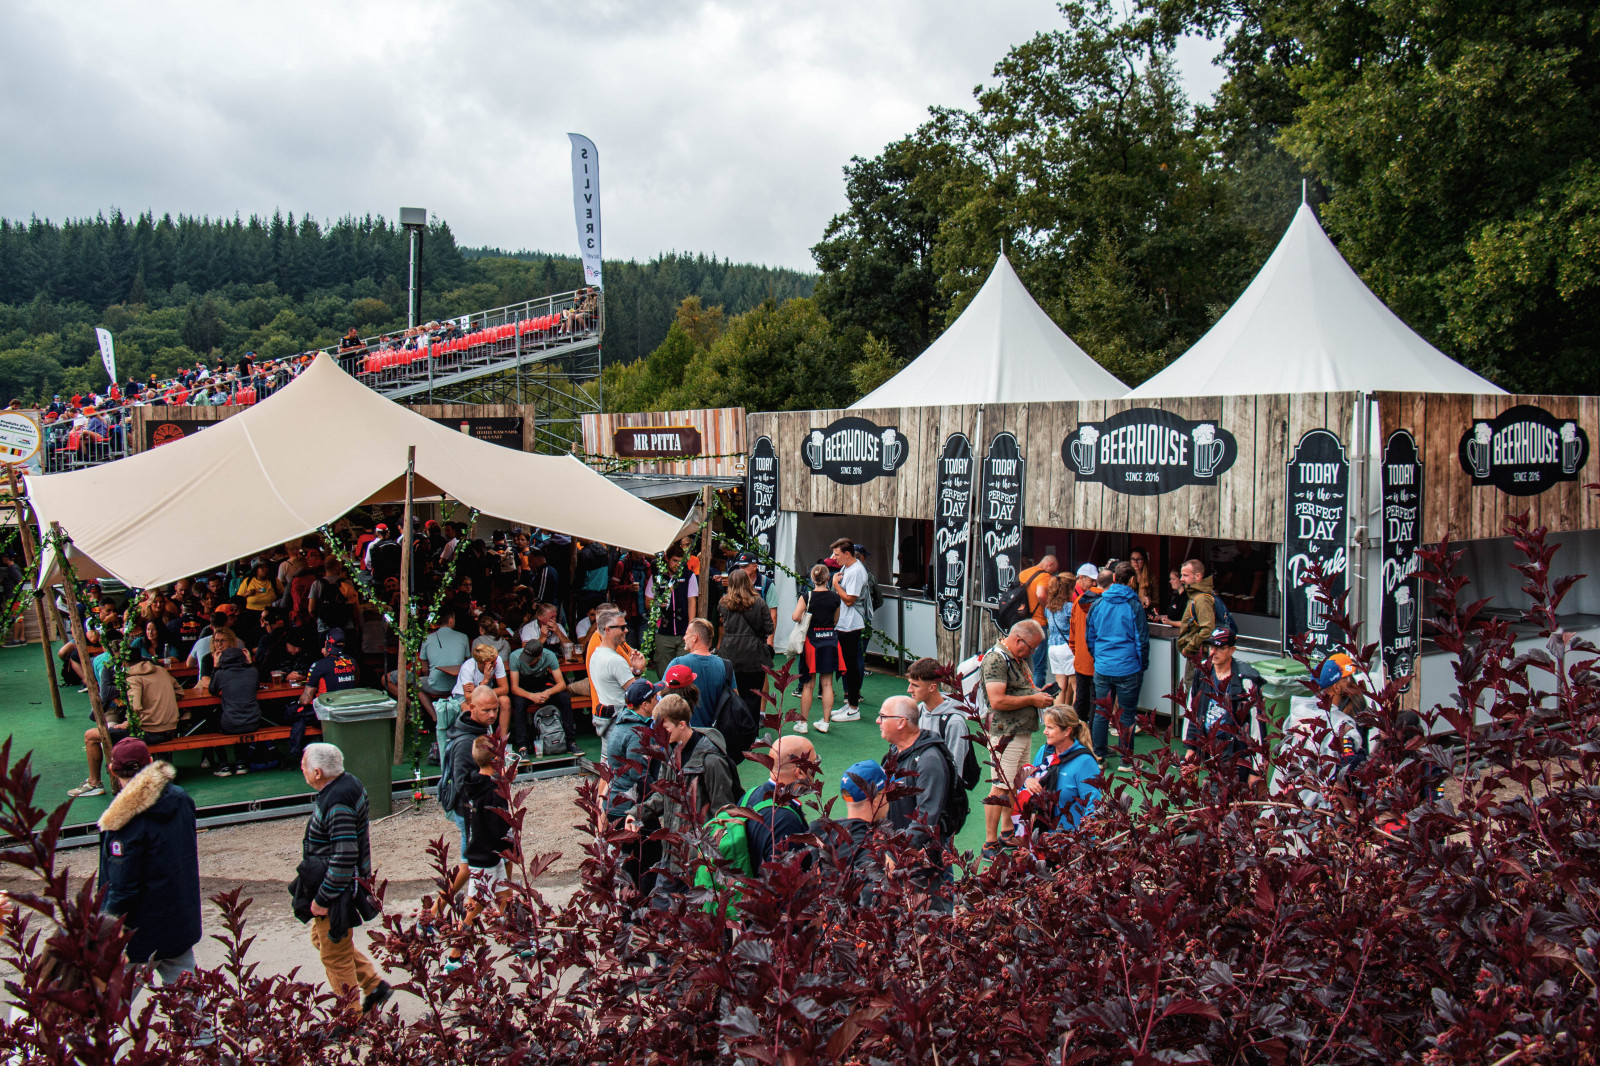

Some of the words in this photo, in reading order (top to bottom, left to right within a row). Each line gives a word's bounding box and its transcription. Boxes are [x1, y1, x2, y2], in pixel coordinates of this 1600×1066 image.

[633, 433, 649, 451] MR
[651, 433, 682, 451] PITTA
[825, 429, 880, 462] BEERHOUSE
[1100, 423, 1189, 466] BEERHOUSE
[1493, 421, 1559, 466] BEERHOUSE
[755, 457, 773, 471] TODAY
[840, 466, 852, 475] SINCE
[944, 458, 969, 475] TODAY
[992, 459, 1018, 476] TODAY
[954, 476, 963, 487] the
[1125, 472, 1143, 482] SINCE
[1145, 472, 1160, 482] 2016
[1298, 463, 1340, 484] TODAY
[1387, 464, 1415, 486] TODAY
[1513, 471, 1527, 483] SINCE
[1528, 471, 1541, 482] 2016
[753, 482, 775, 494] PERFECT
[1002, 478, 1011, 490] the
[755, 490, 773, 506] DAY
[941, 488, 969, 502] PERFECT
[988, 489, 1018, 504] PERFECT
[1317, 487, 1332, 501] the
[1400, 488, 1409, 503] the
[942, 497, 966, 517] DAY
[989, 500, 1015, 520] DAY
[1294, 502, 1343, 520] PERFECT
[1385, 505, 1417, 520] PERFECT
[1298, 514, 1339, 541] DAY
[1387, 517, 1414, 542] DAY
[936, 521, 968, 555] Drink
[985, 525, 1021, 559] Drink
[1383, 545, 1419, 595] Drink
[944, 586, 958, 597] ENJOY
[1394, 636, 1411, 650] ENJOY
